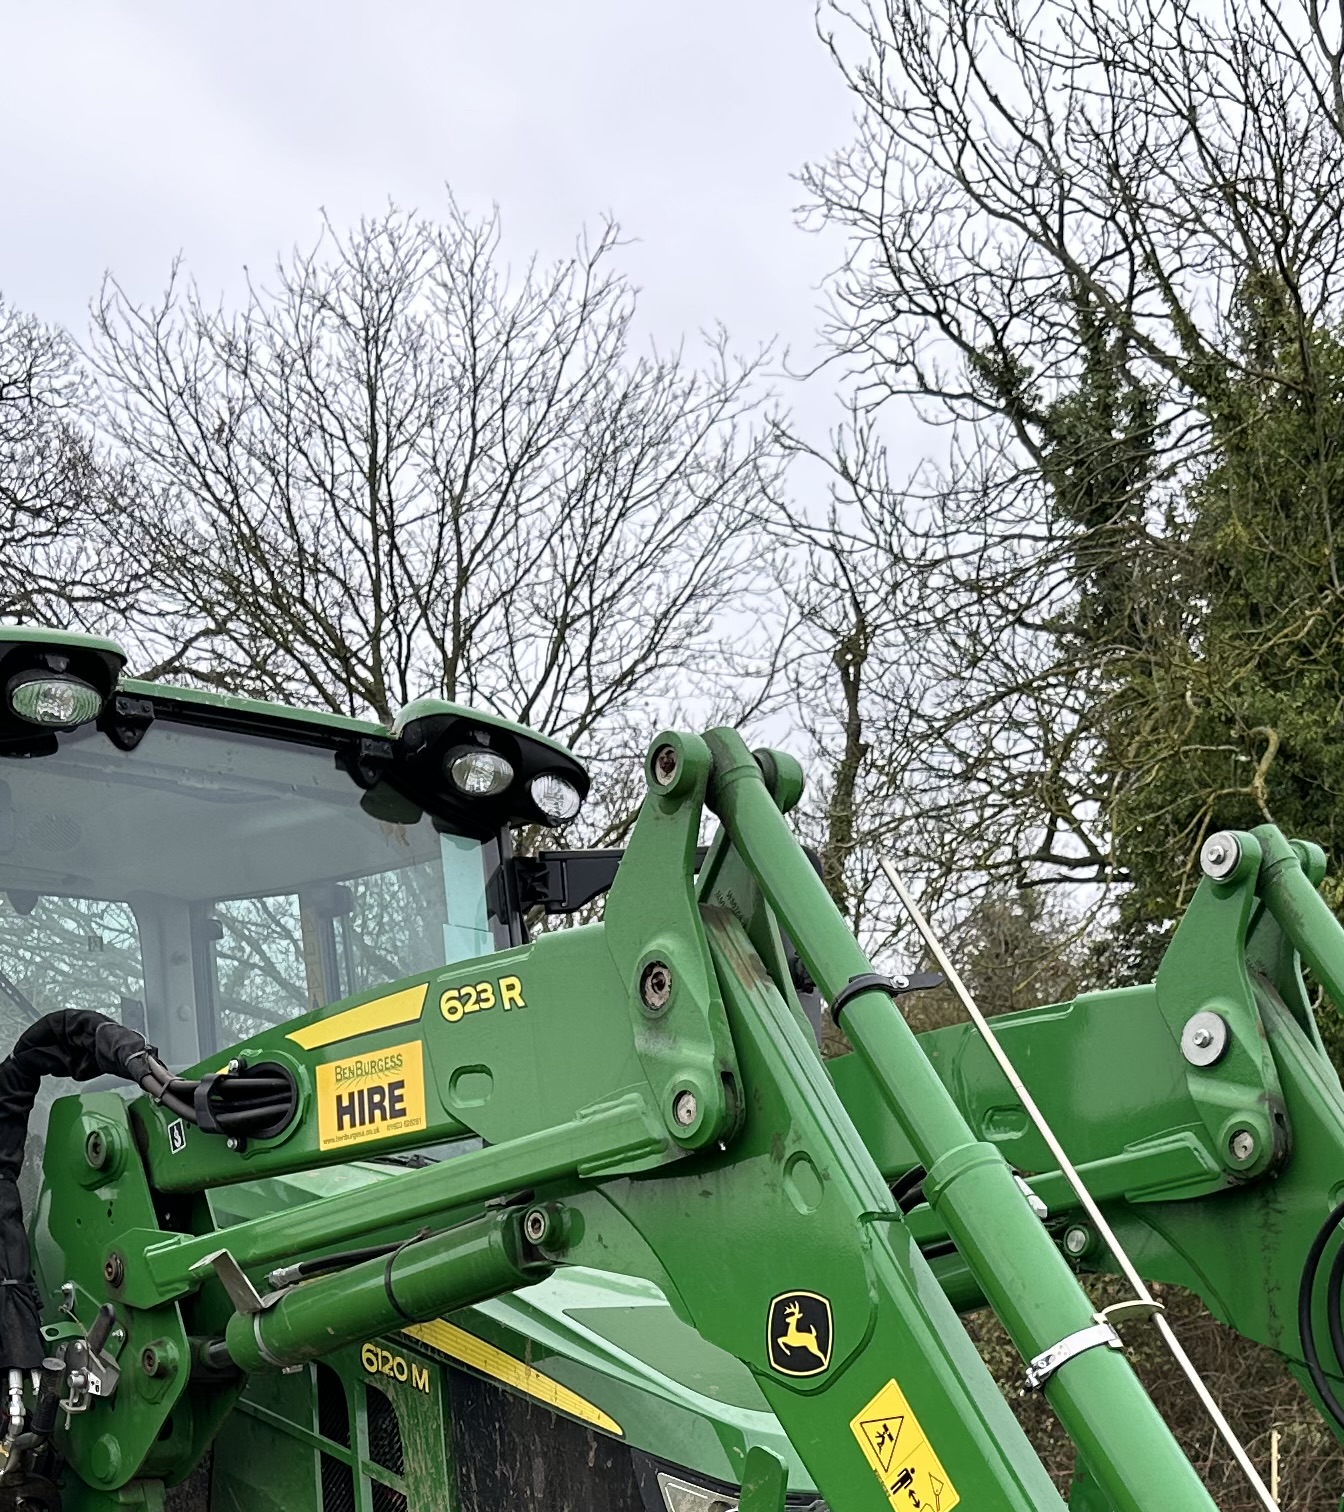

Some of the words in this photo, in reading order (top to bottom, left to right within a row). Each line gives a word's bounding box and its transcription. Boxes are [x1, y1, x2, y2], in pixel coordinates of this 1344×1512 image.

[440, 982, 496, 1022] 623
[499, 976, 526, 1011] R
[336, 1079, 407, 1132] HIRE
[361, 1342, 408, 1382] 6120
[412, 1363, 430, 1394] M
